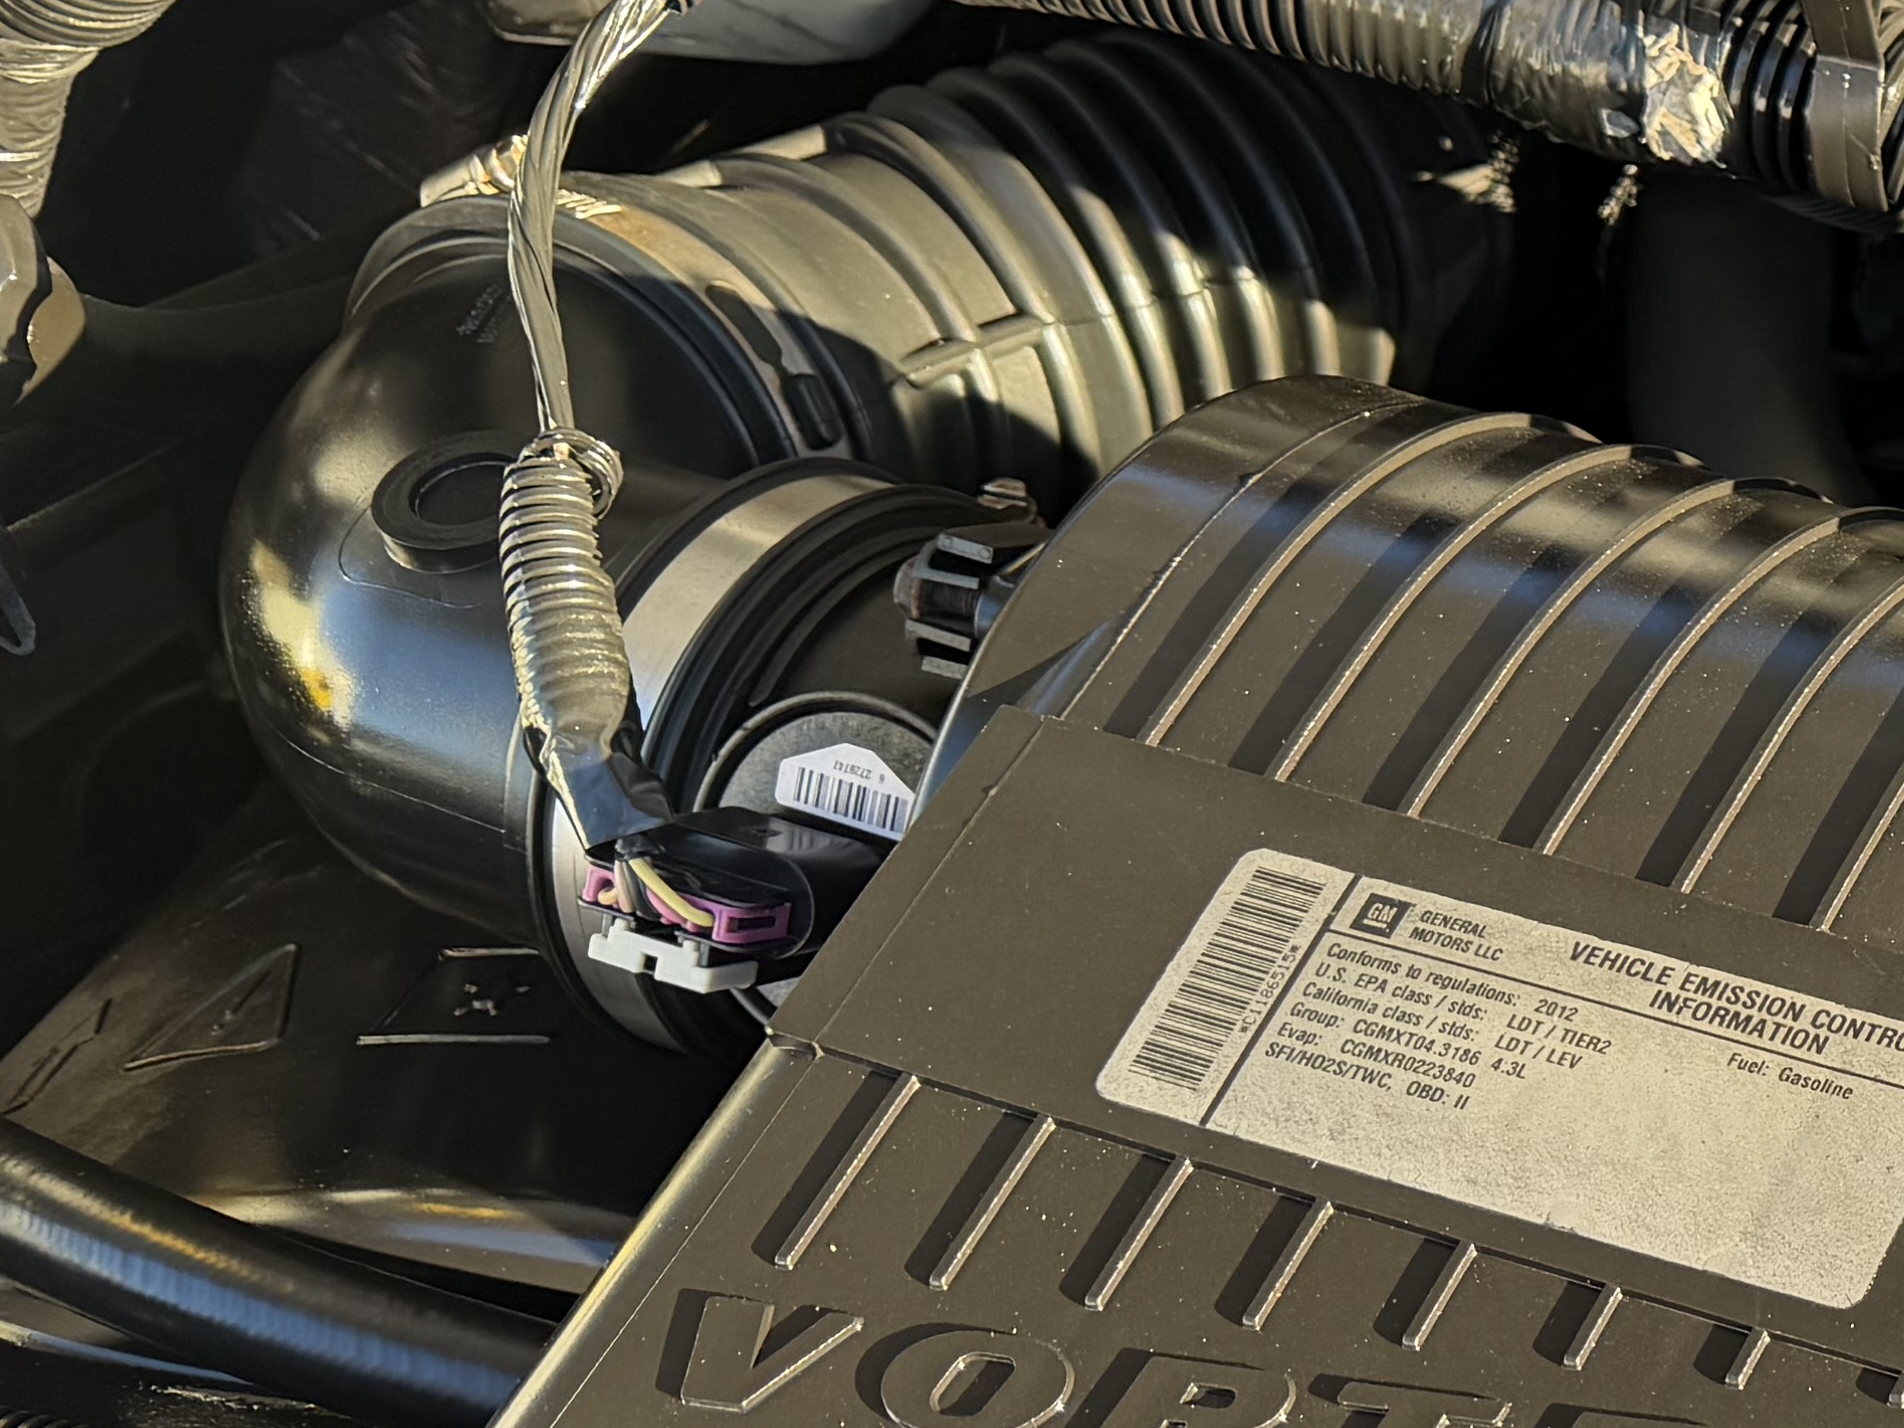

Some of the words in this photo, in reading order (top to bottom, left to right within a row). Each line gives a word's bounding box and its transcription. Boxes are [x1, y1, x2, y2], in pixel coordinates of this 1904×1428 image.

[1409, 926, 1473, 954] MOTORS
[1474, 944, 1504, 961] LLC
[1419, 909, 1489, 939] GENERAL
[1314, 962, 1347, 984] U.S.
[1354, 972, 1388, 995] EPA
[1392, 983, 1432, 1006] class
[1449, 1000, 1488, 1022] stds:
[1507, 1014, 1544, 1037] LDT
[1562, 1029, 1612, 1055] TIER2
[1327, 943, 1402, 974] Conforms
[1406, 964, 1421, 979] to
[1426, 969, 1521, 1007] regulations:
[1534, 999, 1579, 1022] 2012
[1570, 941, 1676, 986] VEHICLE
[1679, 973, 1806, 1024] EMISSION
[1277, 1022, 1322, 1047] Evap:
[1341, 1039, 1476, 1088] CGMXR0223840
[1290, 1002, 1345, 1029] Group:
[1353, 1018, 1482, 1066] CGMXT04.3186
[1491, 1058, 1526, 1080] 4.3L
[1302, 982, 1379, 1014] California
[1382, 1003, 1423, 1027] class
[1439, 1021, 1479, 1043] stds:
[1495, 1035, 1532, 1058] LDT
[1546, 1051, 1583, 1070] LEV
[1649, 989, 1830, 1055] INFORMATION
[1406, 1080, 1451, 1106] OBD:
[1453, 1095, 1471, 1110] II
[1726, 1052, 1769, 1078] Fuel:
[1778, 1066, 1855, 1100] Gasoline
